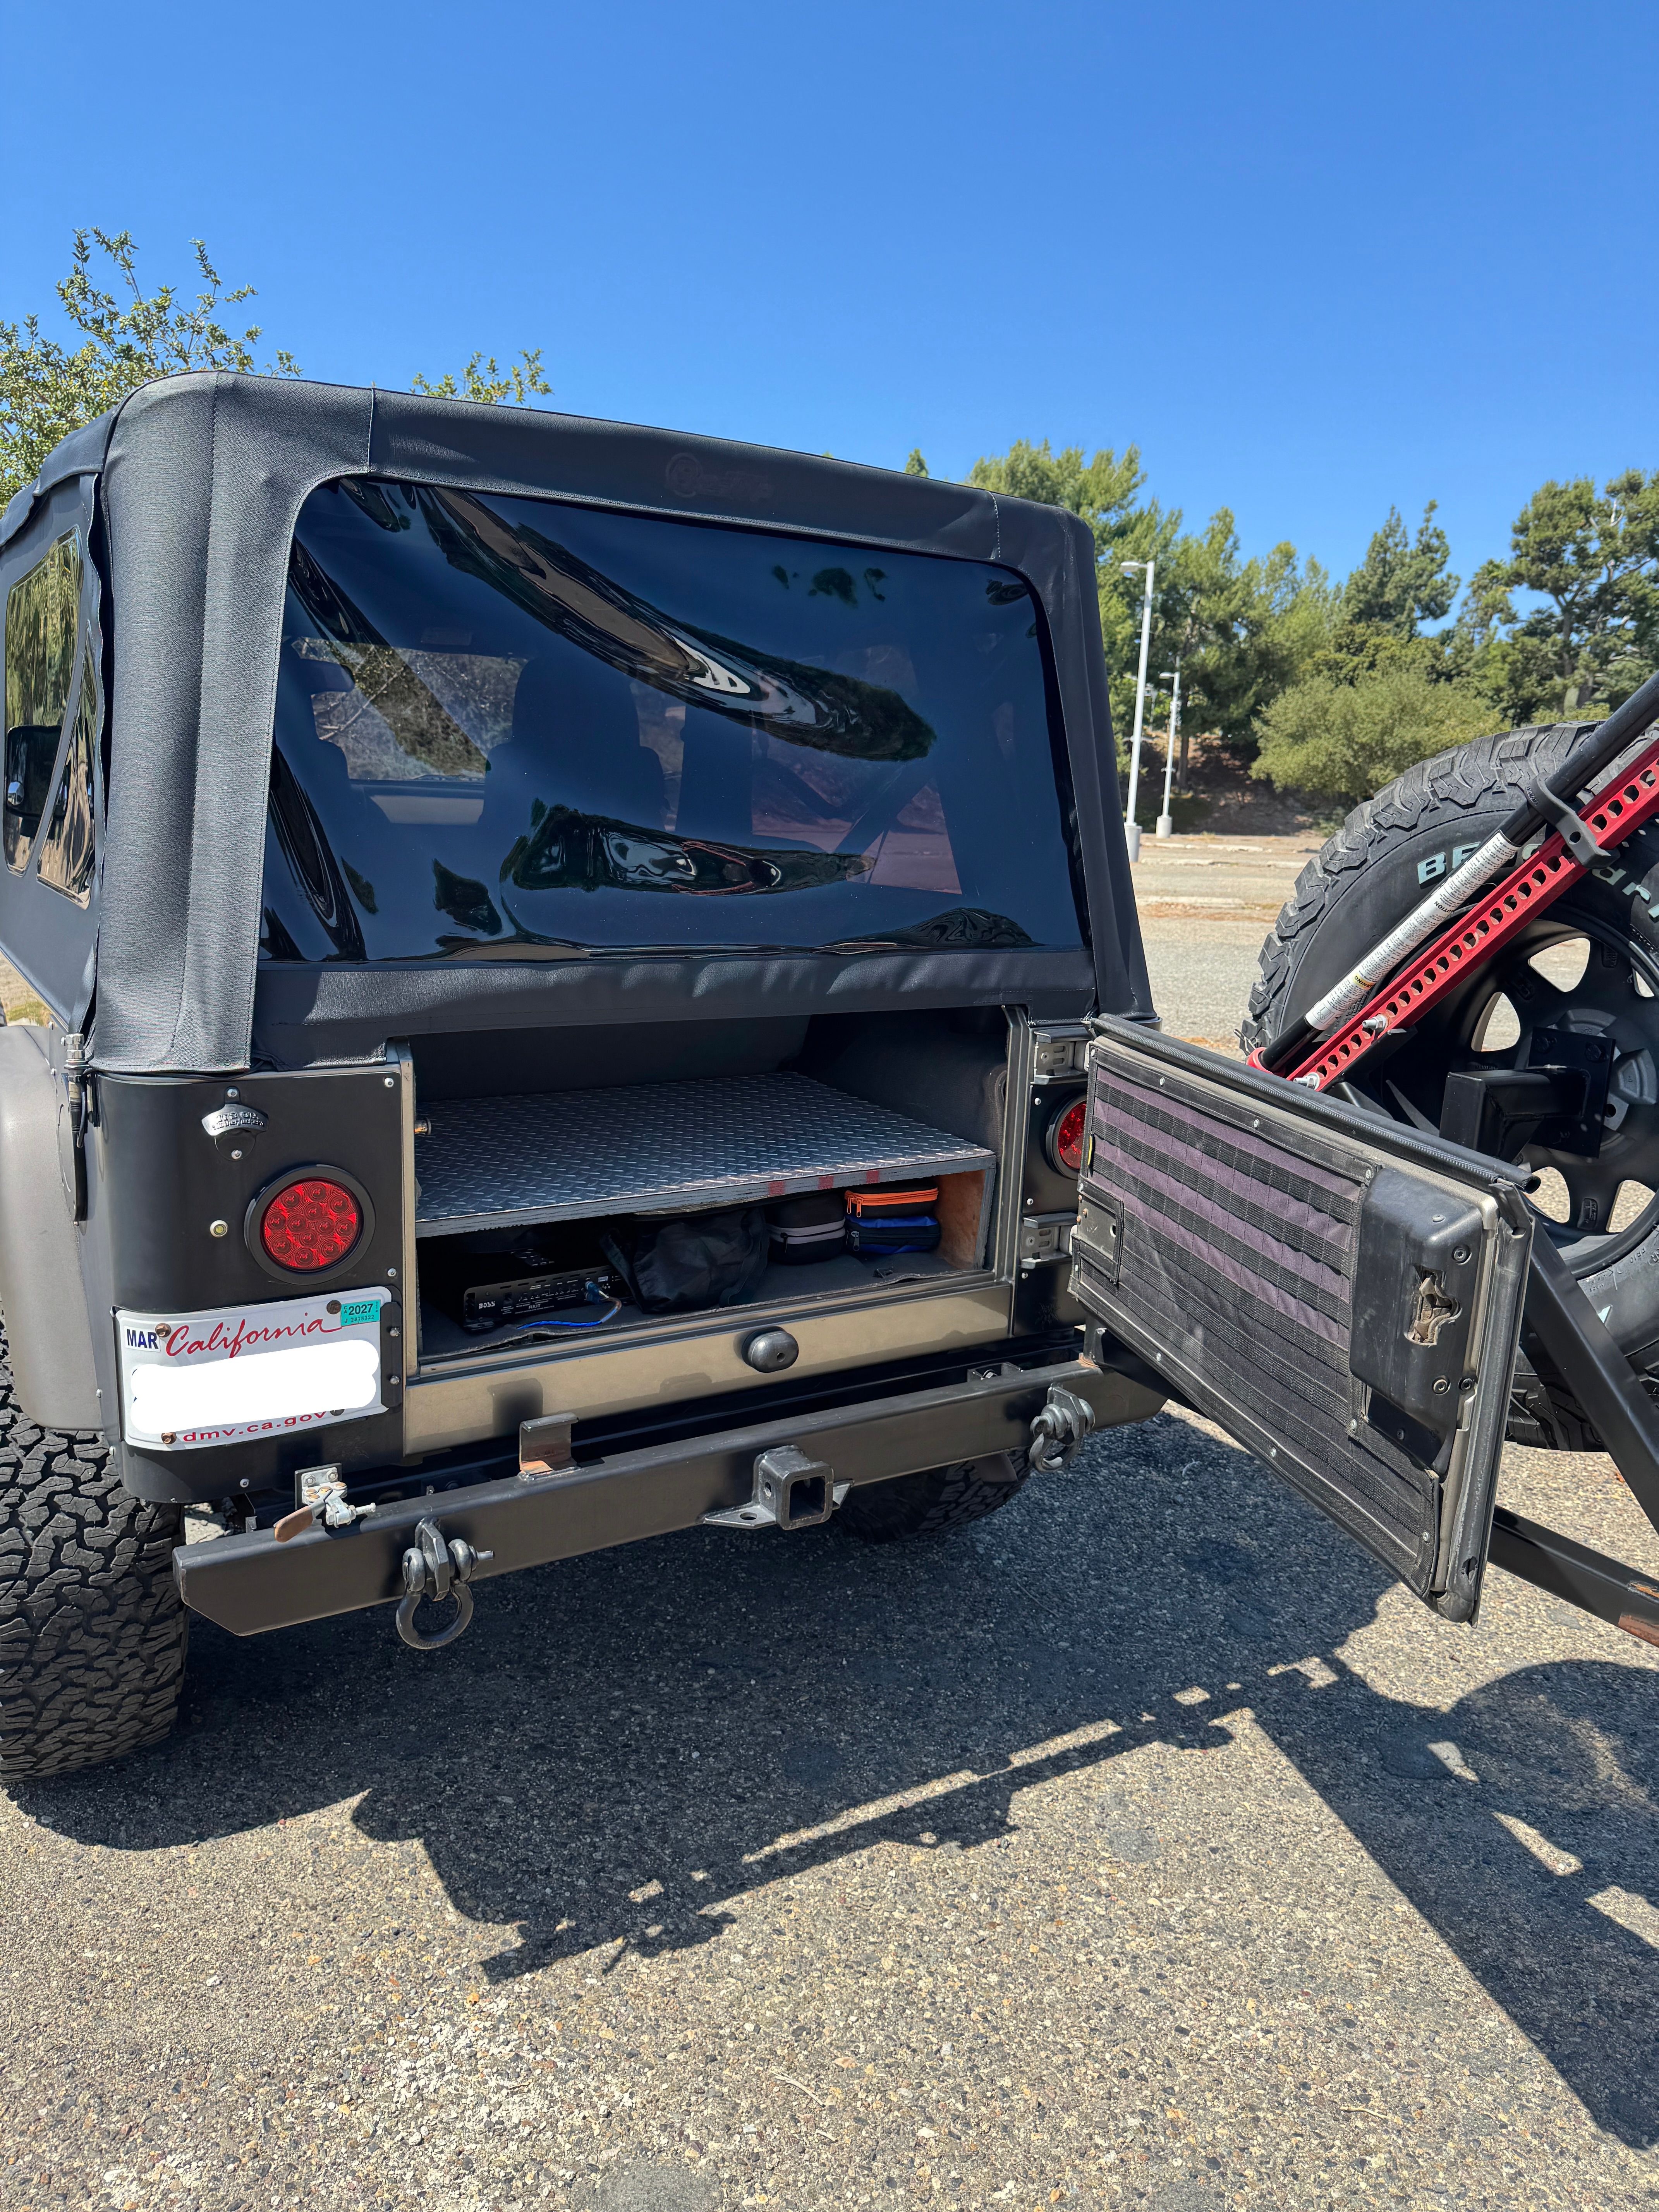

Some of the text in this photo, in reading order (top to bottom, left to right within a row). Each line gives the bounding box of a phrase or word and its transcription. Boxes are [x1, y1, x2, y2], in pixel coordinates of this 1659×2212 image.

[348, 1303, 373, 1316] 2027
[478, 1301, 496, 1309] BOSS
[127, 1329, 159, 1349] MAR
[166, 1312, 342, 1358] California
[183, 1411, 326, 1442] dmv.ca.gov
